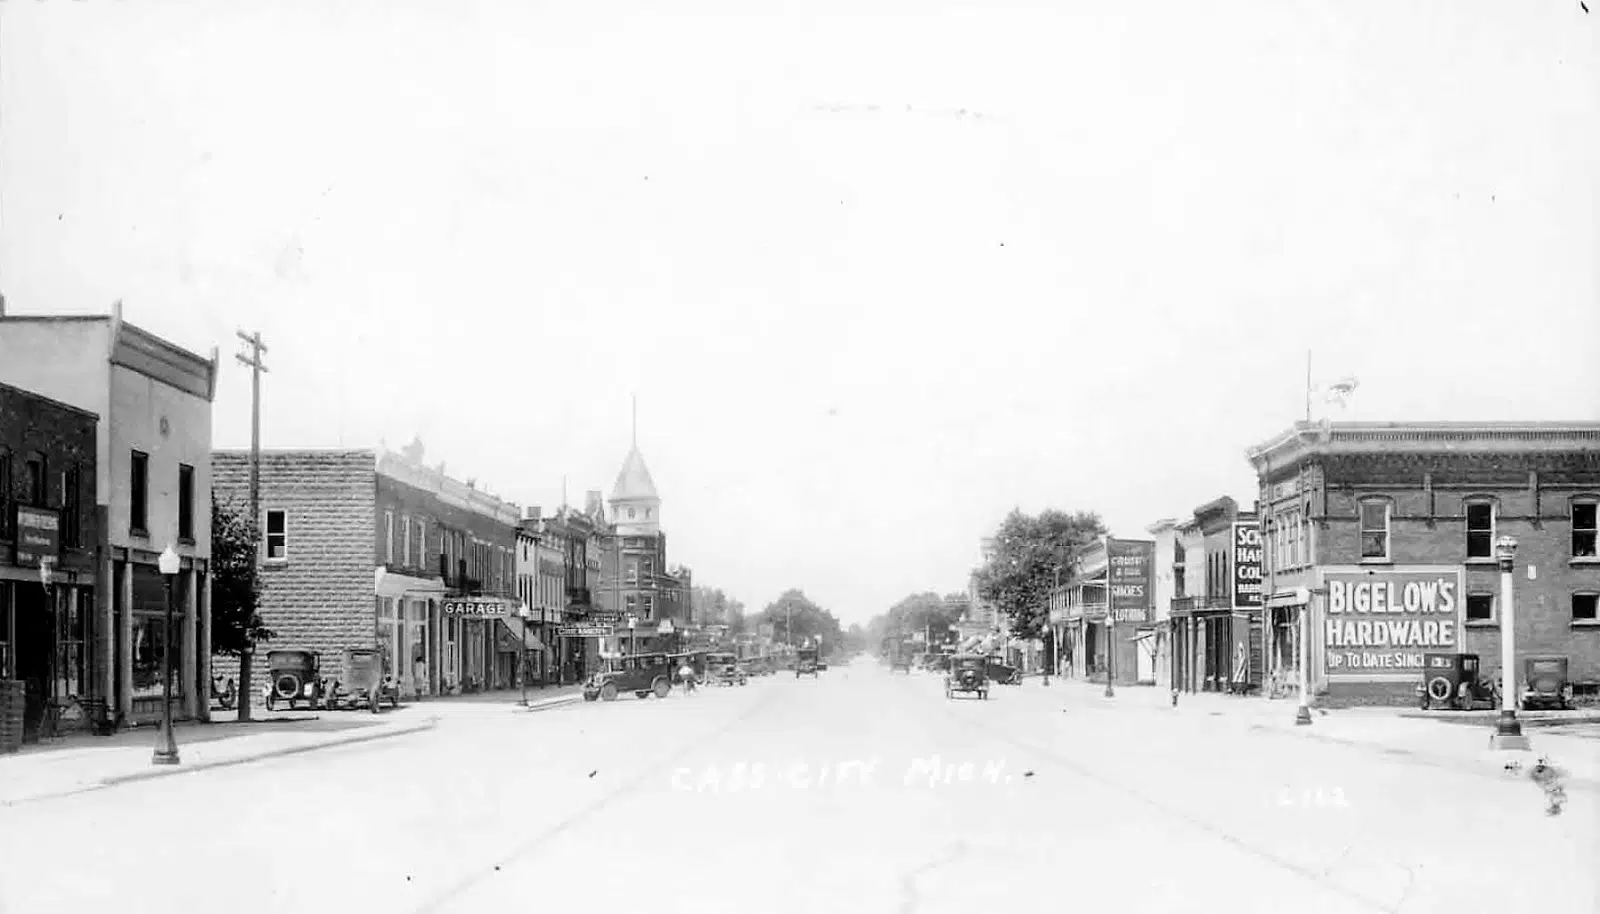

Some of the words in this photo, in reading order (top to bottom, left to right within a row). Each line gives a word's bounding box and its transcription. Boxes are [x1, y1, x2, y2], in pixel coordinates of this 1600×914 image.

[1111, 585, 1144, 597] SHOES
[1329, 578, 1455, 613] BIGELOW'S
[445, 603, 505, 614] GARAGE
[1326, 619, 1455, 646] HARDWARE
[1362, 652, 1393, 667] DATE
